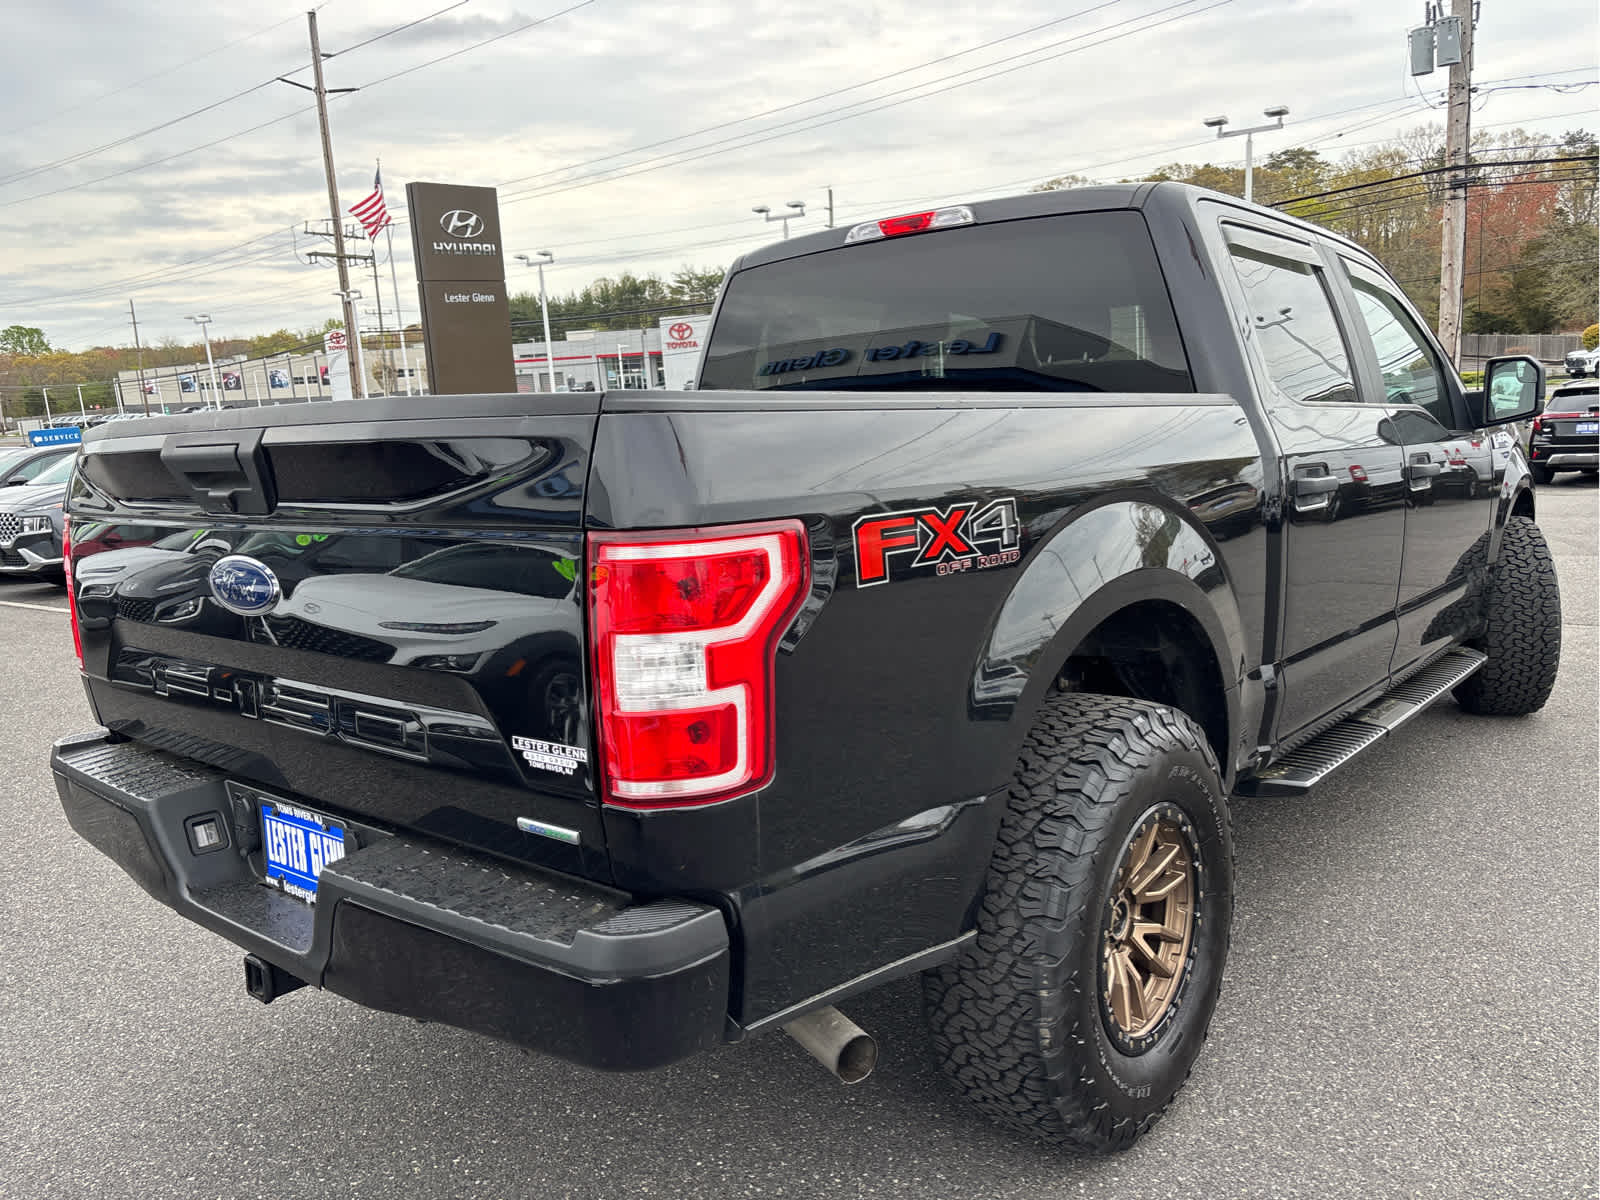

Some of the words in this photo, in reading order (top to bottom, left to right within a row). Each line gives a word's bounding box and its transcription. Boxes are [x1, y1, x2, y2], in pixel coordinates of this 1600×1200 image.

[432, 241, 497, 255] HYUNDAI
[444, 291, 470, 303] Lester
[472, 292, 496, 303] Glenn
[664, 340, 699, 351] TOYOTA
[43, 432, 80, 442] SERVICE
[851, 497, 1021, 588] FX4
[935, 557, 972, 576] OFF
[976, 549, 1021, 569] ROAD
[512, 736, 549, 753] LESTER
[551, 744, 588, 761] GLENN
[265, 818, 308, 873] LESTER
